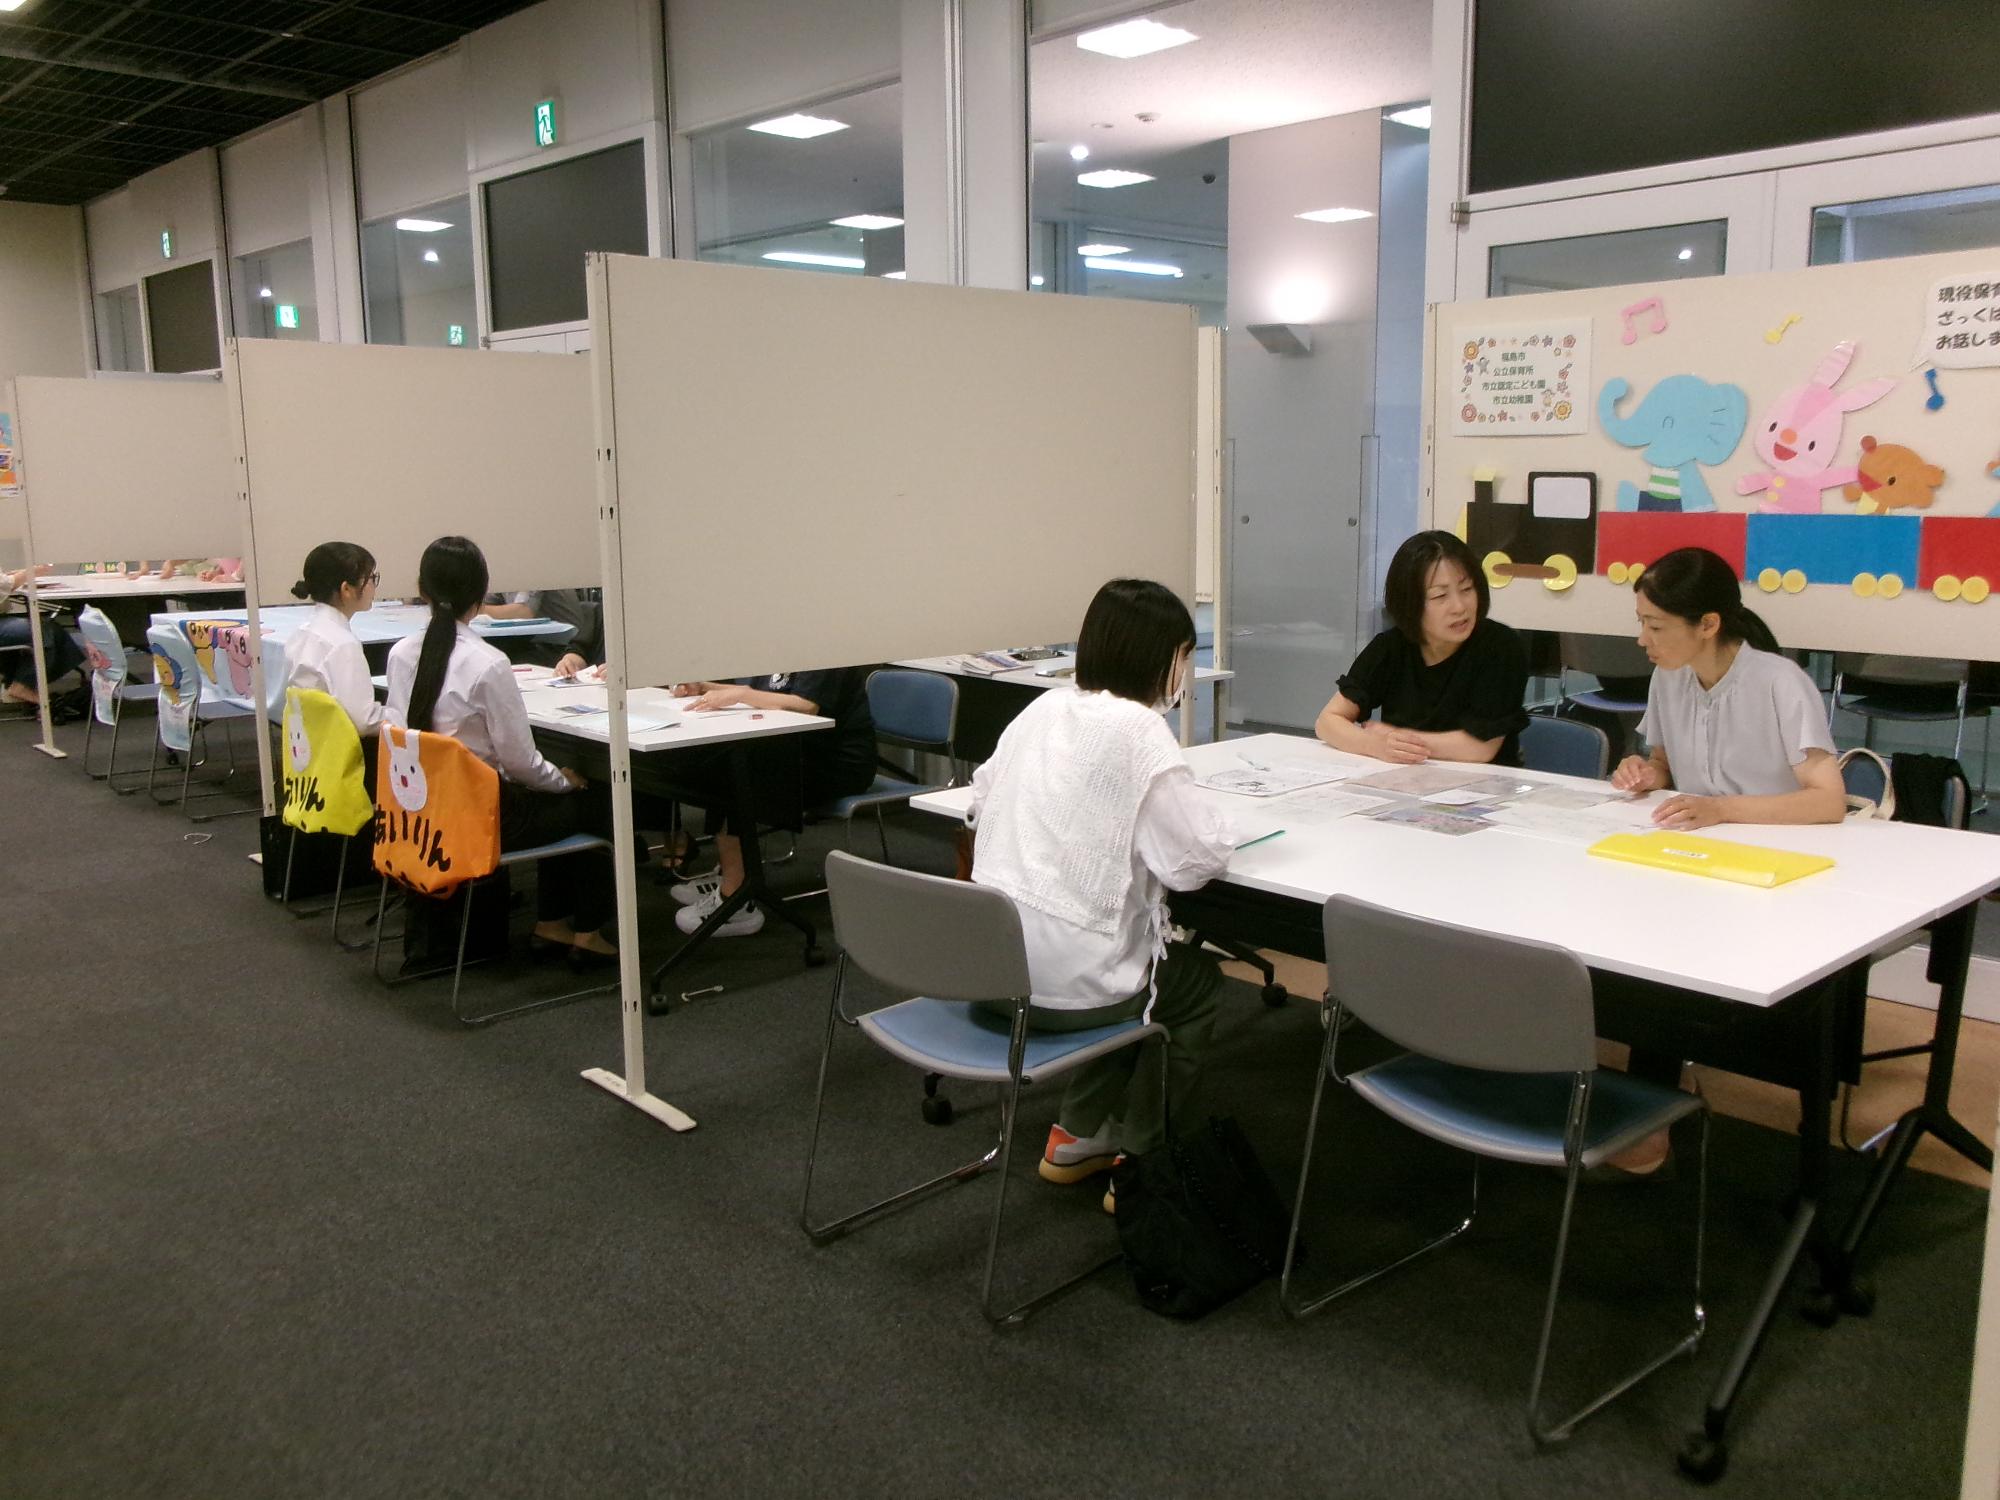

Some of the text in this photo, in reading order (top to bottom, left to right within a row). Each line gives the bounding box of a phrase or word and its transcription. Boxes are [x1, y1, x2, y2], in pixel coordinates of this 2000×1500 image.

[1501, 352, 1526, 362] 福島市
[1493, 365, 1534, 377] 公立保育所
[1482, 379, 1546, 391] 市立認定こども園
[1493, 394, 1534, 405] 市立幼稚園
